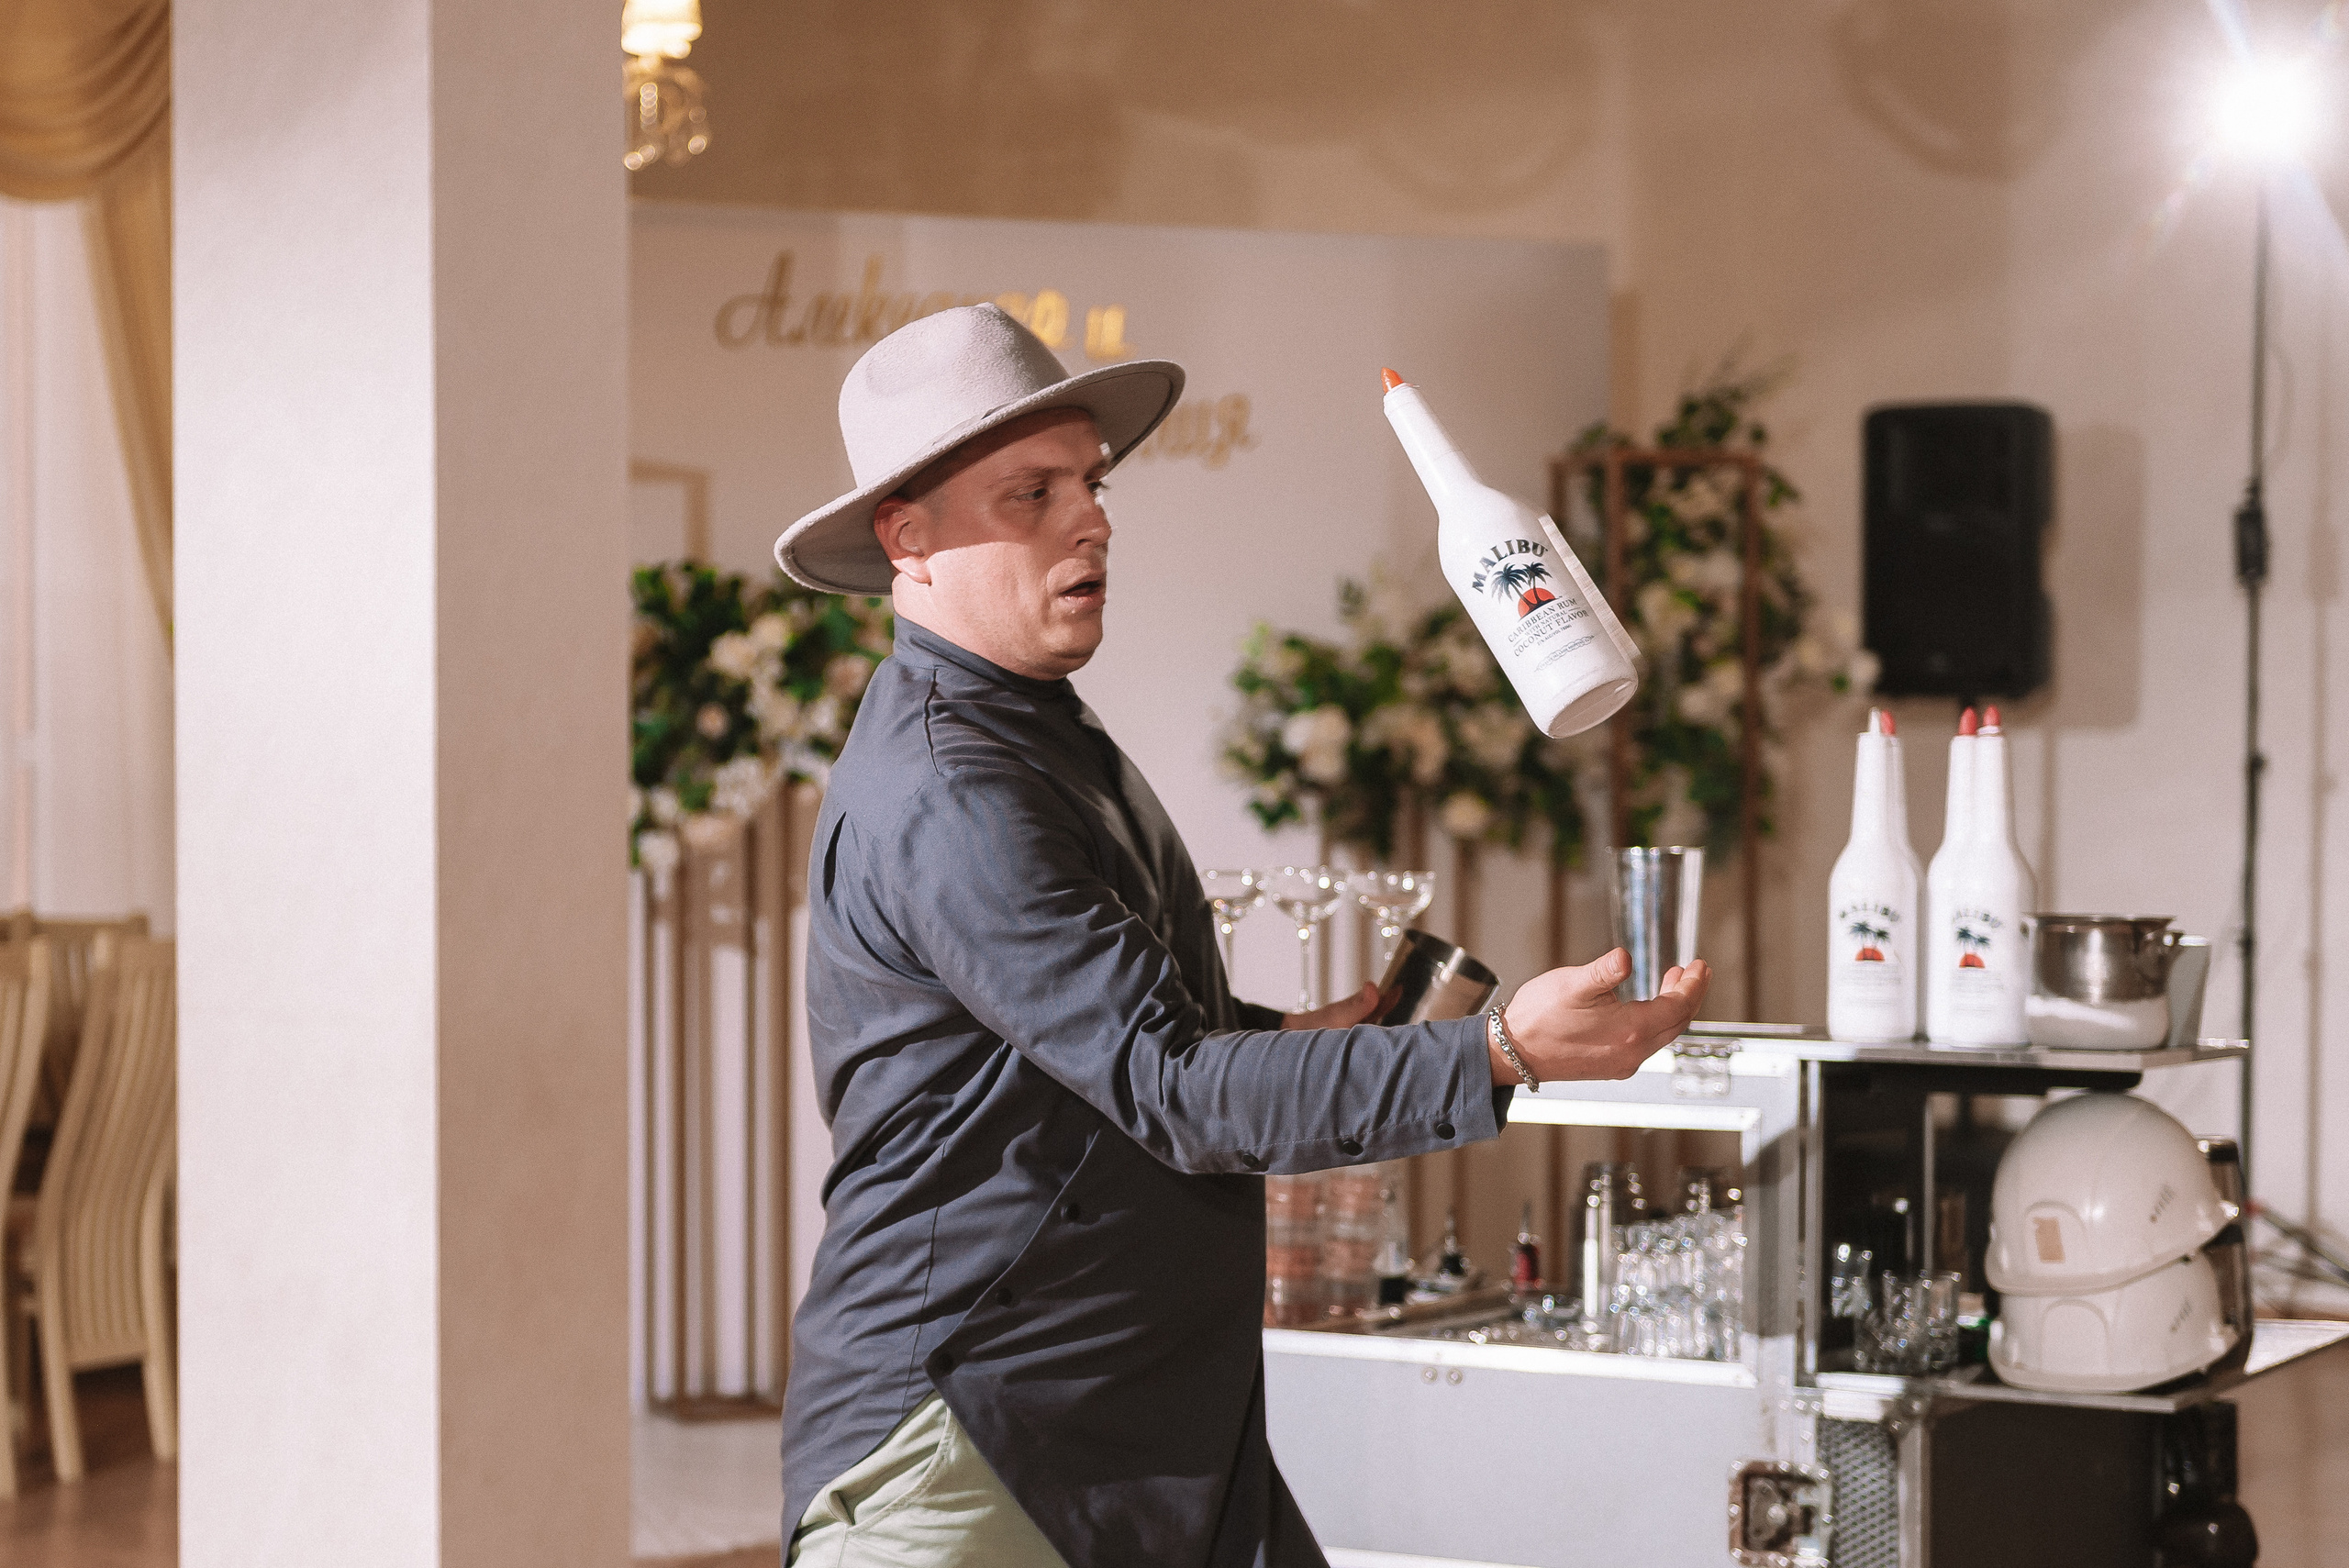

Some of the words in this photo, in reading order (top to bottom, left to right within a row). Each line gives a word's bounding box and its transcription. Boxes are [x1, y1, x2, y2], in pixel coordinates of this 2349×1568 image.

[1472, 539, 1548, 594] MALIBU
[1508, 606, 1556, 643] CARIBBEAN
[1557, 597, 1577, 611] RUM
[1514, 625, 1554, 657] COCONUT
[1555, 609, 1589, 628] FLAVOR
[1541, 610, 1568, 628] NATURAL
